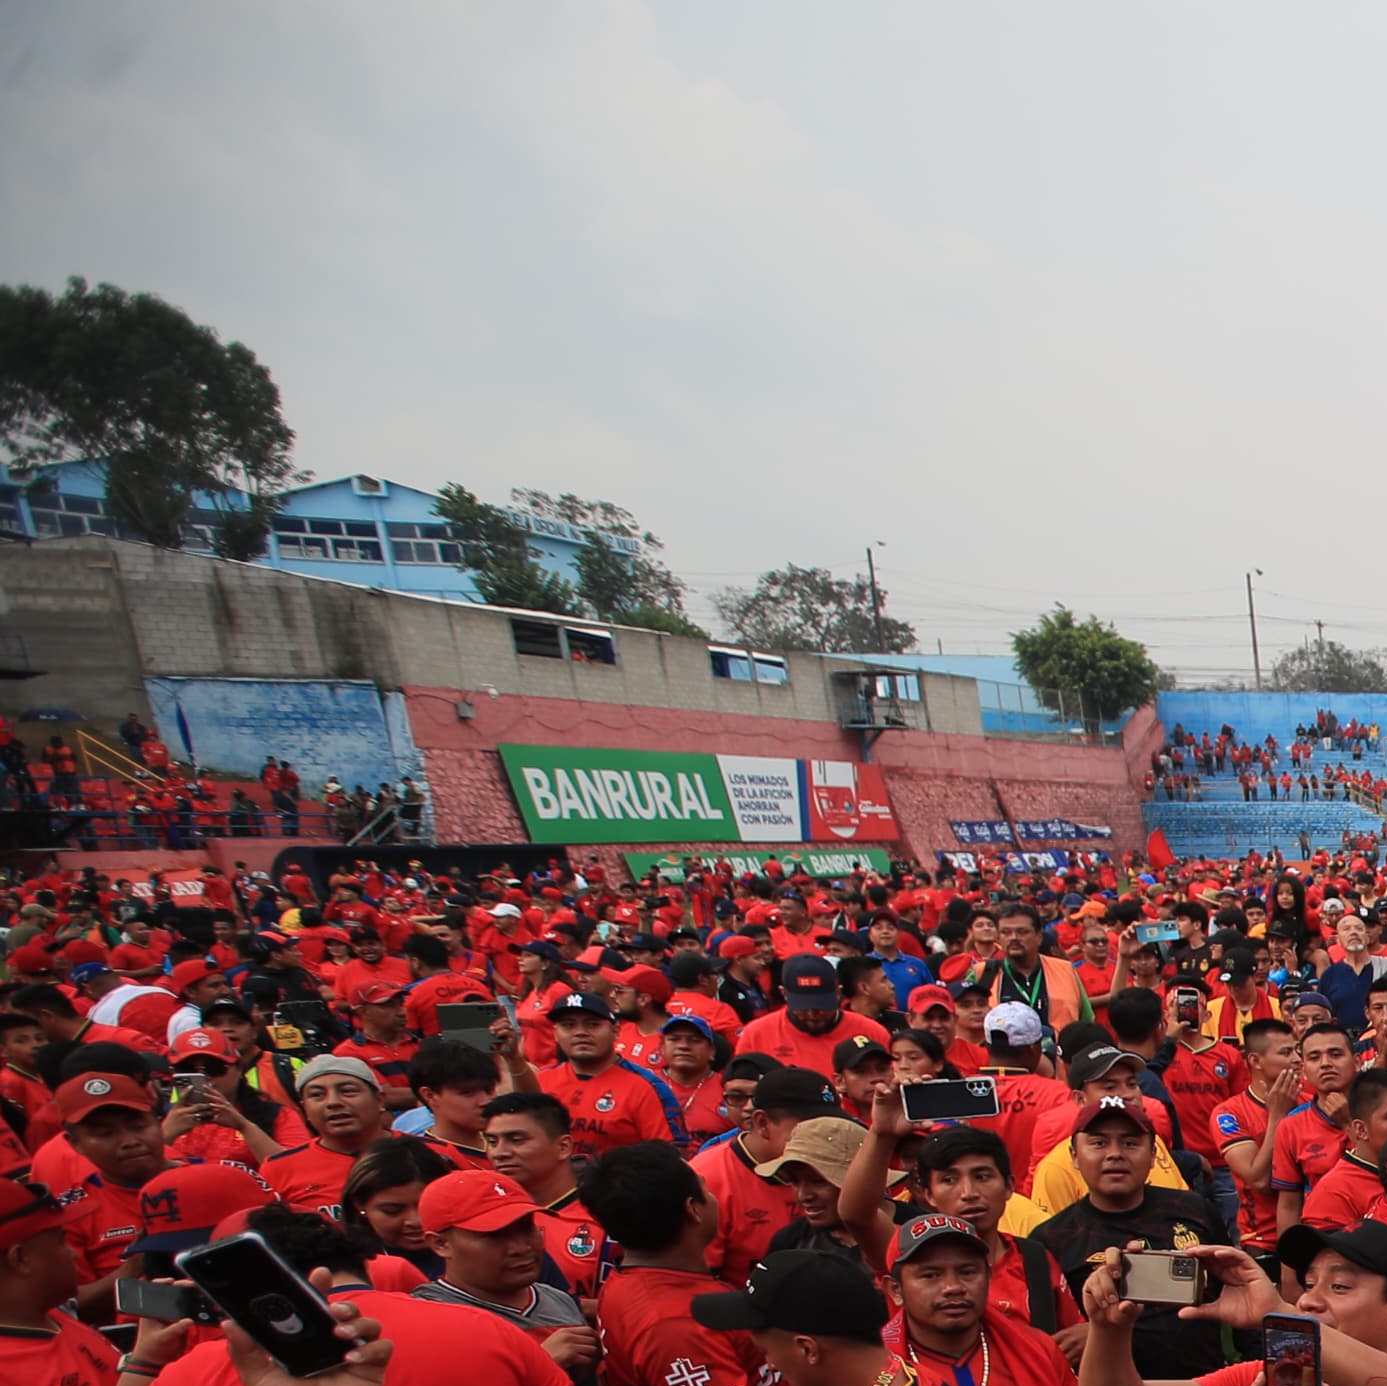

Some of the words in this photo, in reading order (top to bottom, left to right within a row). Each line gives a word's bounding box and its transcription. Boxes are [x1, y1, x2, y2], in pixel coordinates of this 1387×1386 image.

[728, 774, 747, 785] LOS
[750, 775, 788, 787] MIMADOS
[521, 767, 724, 820] BANRURAL
[733, 788, 744, 799] DE
[749, 788, 759, 799] LA
[738, 801, 780, 811] AHORRAN
[741, 813, 761, 825] CON
[763, 813, 794, 825] PASIÓN
